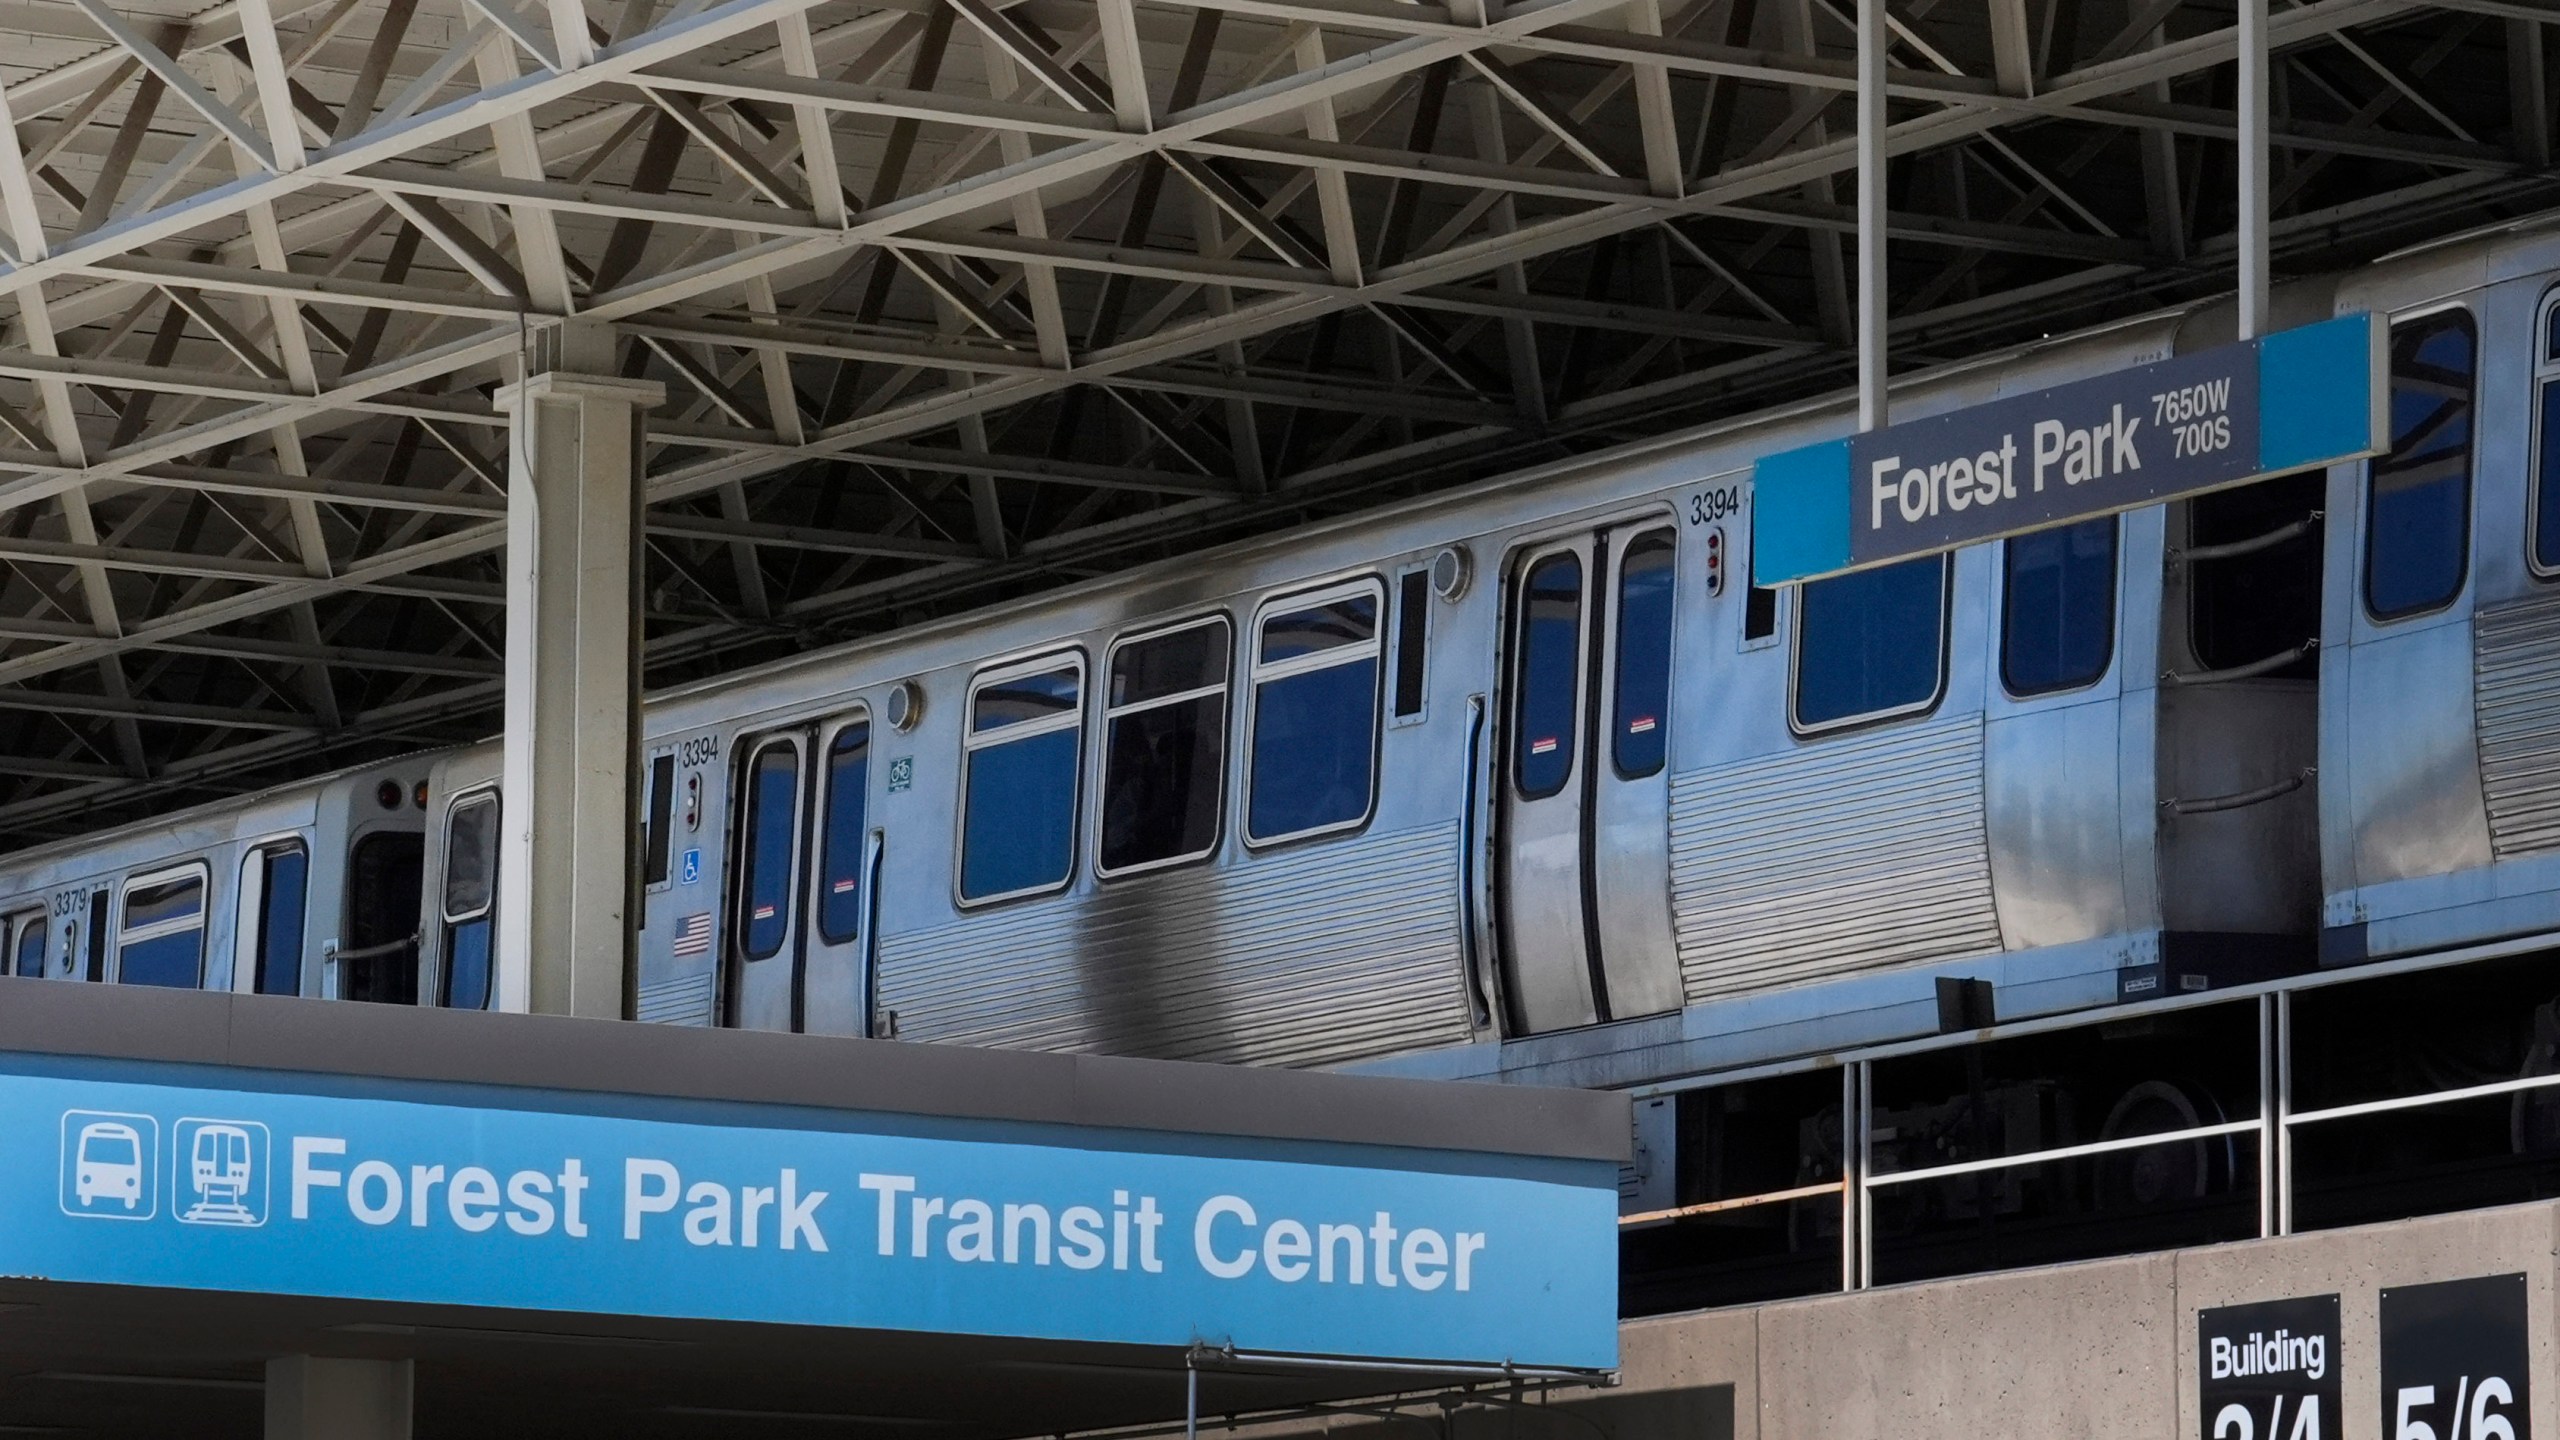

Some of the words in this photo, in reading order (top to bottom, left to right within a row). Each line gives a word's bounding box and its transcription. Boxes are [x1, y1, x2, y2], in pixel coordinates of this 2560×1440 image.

[2152, 378, 2230, 427] 7650W
[2171, 415, 2230, 459] 700S
[1871, 434, 2017, 529] Forest
[2034, 404, 2140, 492] Park
[1691, 486, 1738, 525] 3394
[683, 735, 719, 768] 3394
[55, 887, 87, 917] 3379
[293, 1137, 588, 1237] Forest
[625, 1159, 828, 1251] Park
[860, 1174, 1163, 1272] Transit
[1196, 1196, 1485, 1291] Center
[2211, 1329, 2325, 1380] Building
[2396, 1376, 2516, 1440] 5/6
